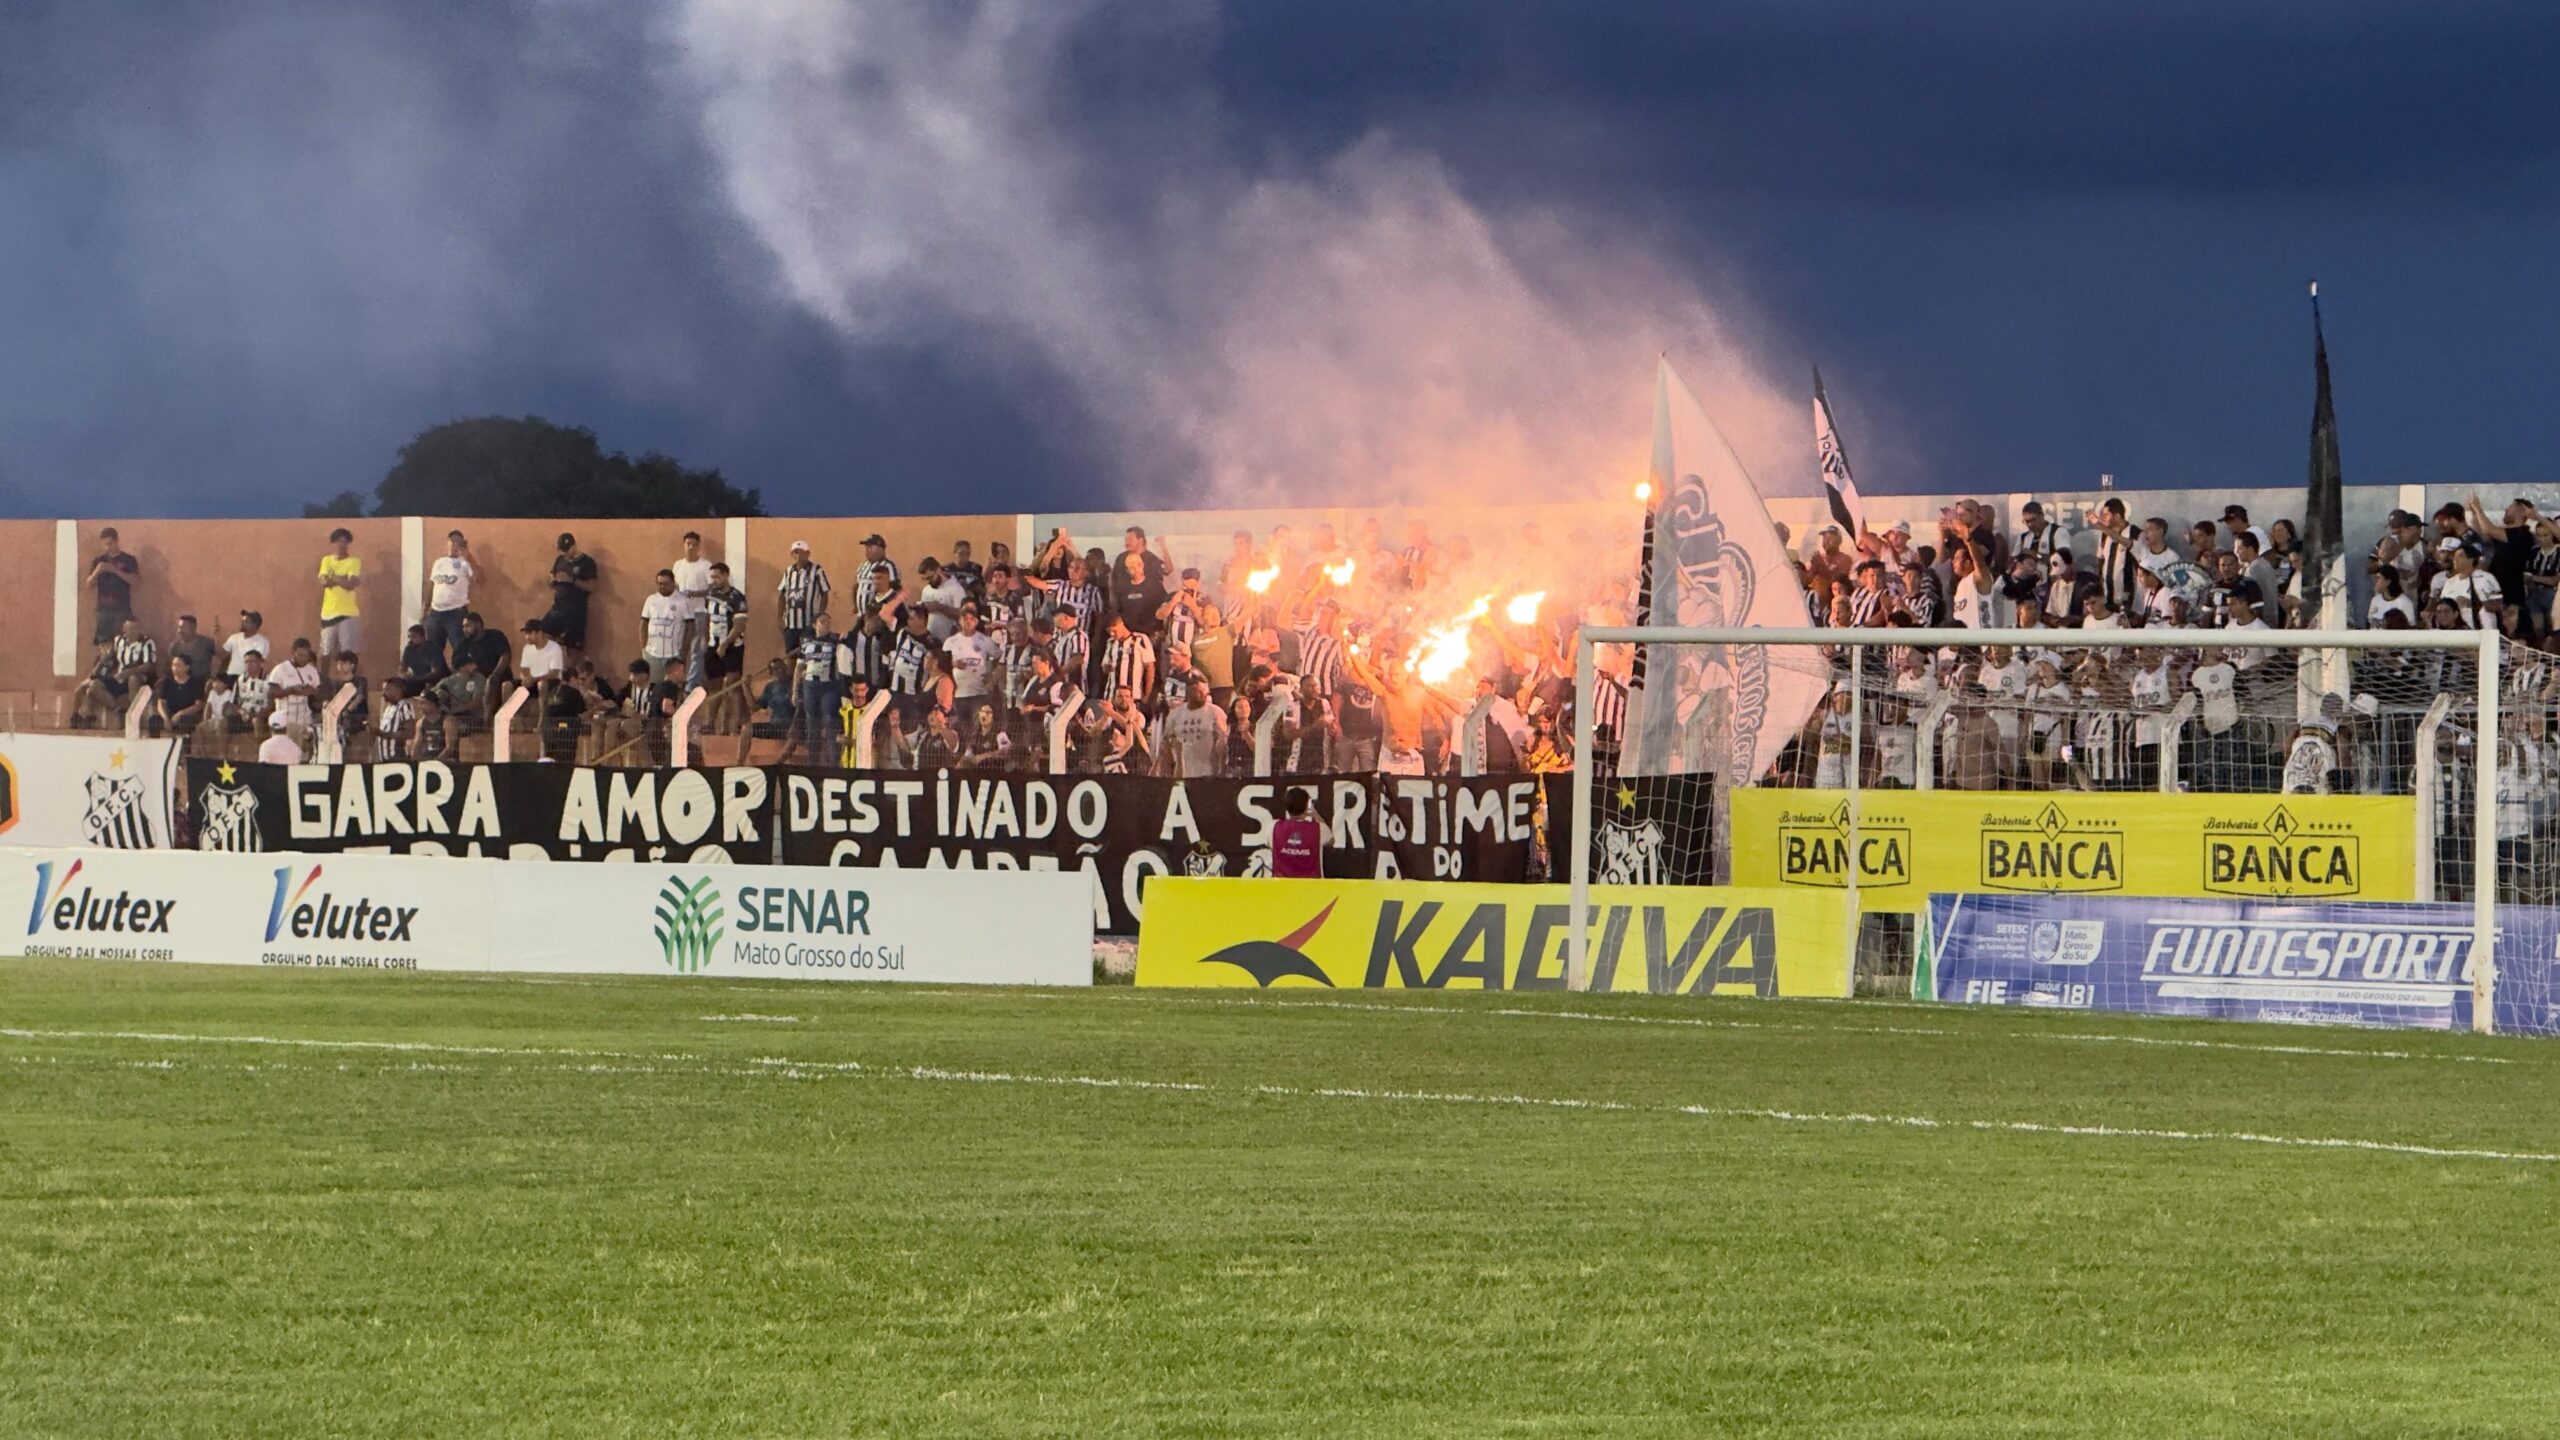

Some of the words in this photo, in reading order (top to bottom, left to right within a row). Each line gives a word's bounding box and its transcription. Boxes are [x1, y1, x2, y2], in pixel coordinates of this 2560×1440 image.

[288, 761, 501, 839] GARRA
[559, 766, 768, 846] AMOR
[1160, 780, 1201, 844] A
[1981, 813, 2032, 826] Barbearia
[2046, 809, 2059, 829] A
[2203, 817, 2258, 830] Barbearia
[2274, 813, 2288, 833] A
[1786, 836, 1905, 876] BANCA
[1989, 839, 2117, 880] BANCA
[2212, 843, 2353, 886] BANCA
[27, 858, 177, 936] Velutex
[265, 864, 419, 943] Velutex
[736, 886, 871, 936] SENAR
[1996, 924, 2029, 934] SETESC
[2065, 930, 2088, 940] Mato
[24, 945, 72, 958] ORGULHO
[76, 947, 95, 958] DAS
[100, 947, 137, 960] NOSSAS
[141, 948, 174, 960] CORES
[734, 941, 781, 965] Mato
[785, 942, 846, 967] Grosso
[850, 943, 873, 969] do
[877, 945, 905, 970] Sul
[1364, 900, 1779, 998] KAGIVA
[2062, 950, 2074, 960] do
[2063, 941, 2094, 950] Grosso
[262, 953, 312, 965] ORGULHO
[316, 955, 336, 966] DAS
[341, 956, 379, 968] NOSSAS
[383, 957, 417, 969] CORES
[1965, 980, 2008, 1004] FIE
[2034, 982, 2061, 993] DISQUE
[2063, 983, 2095, 1005] 181
[2257, 1007, 2292, 1020] Novas
[2296, 1008, 2364, 1023] Conquistas!
